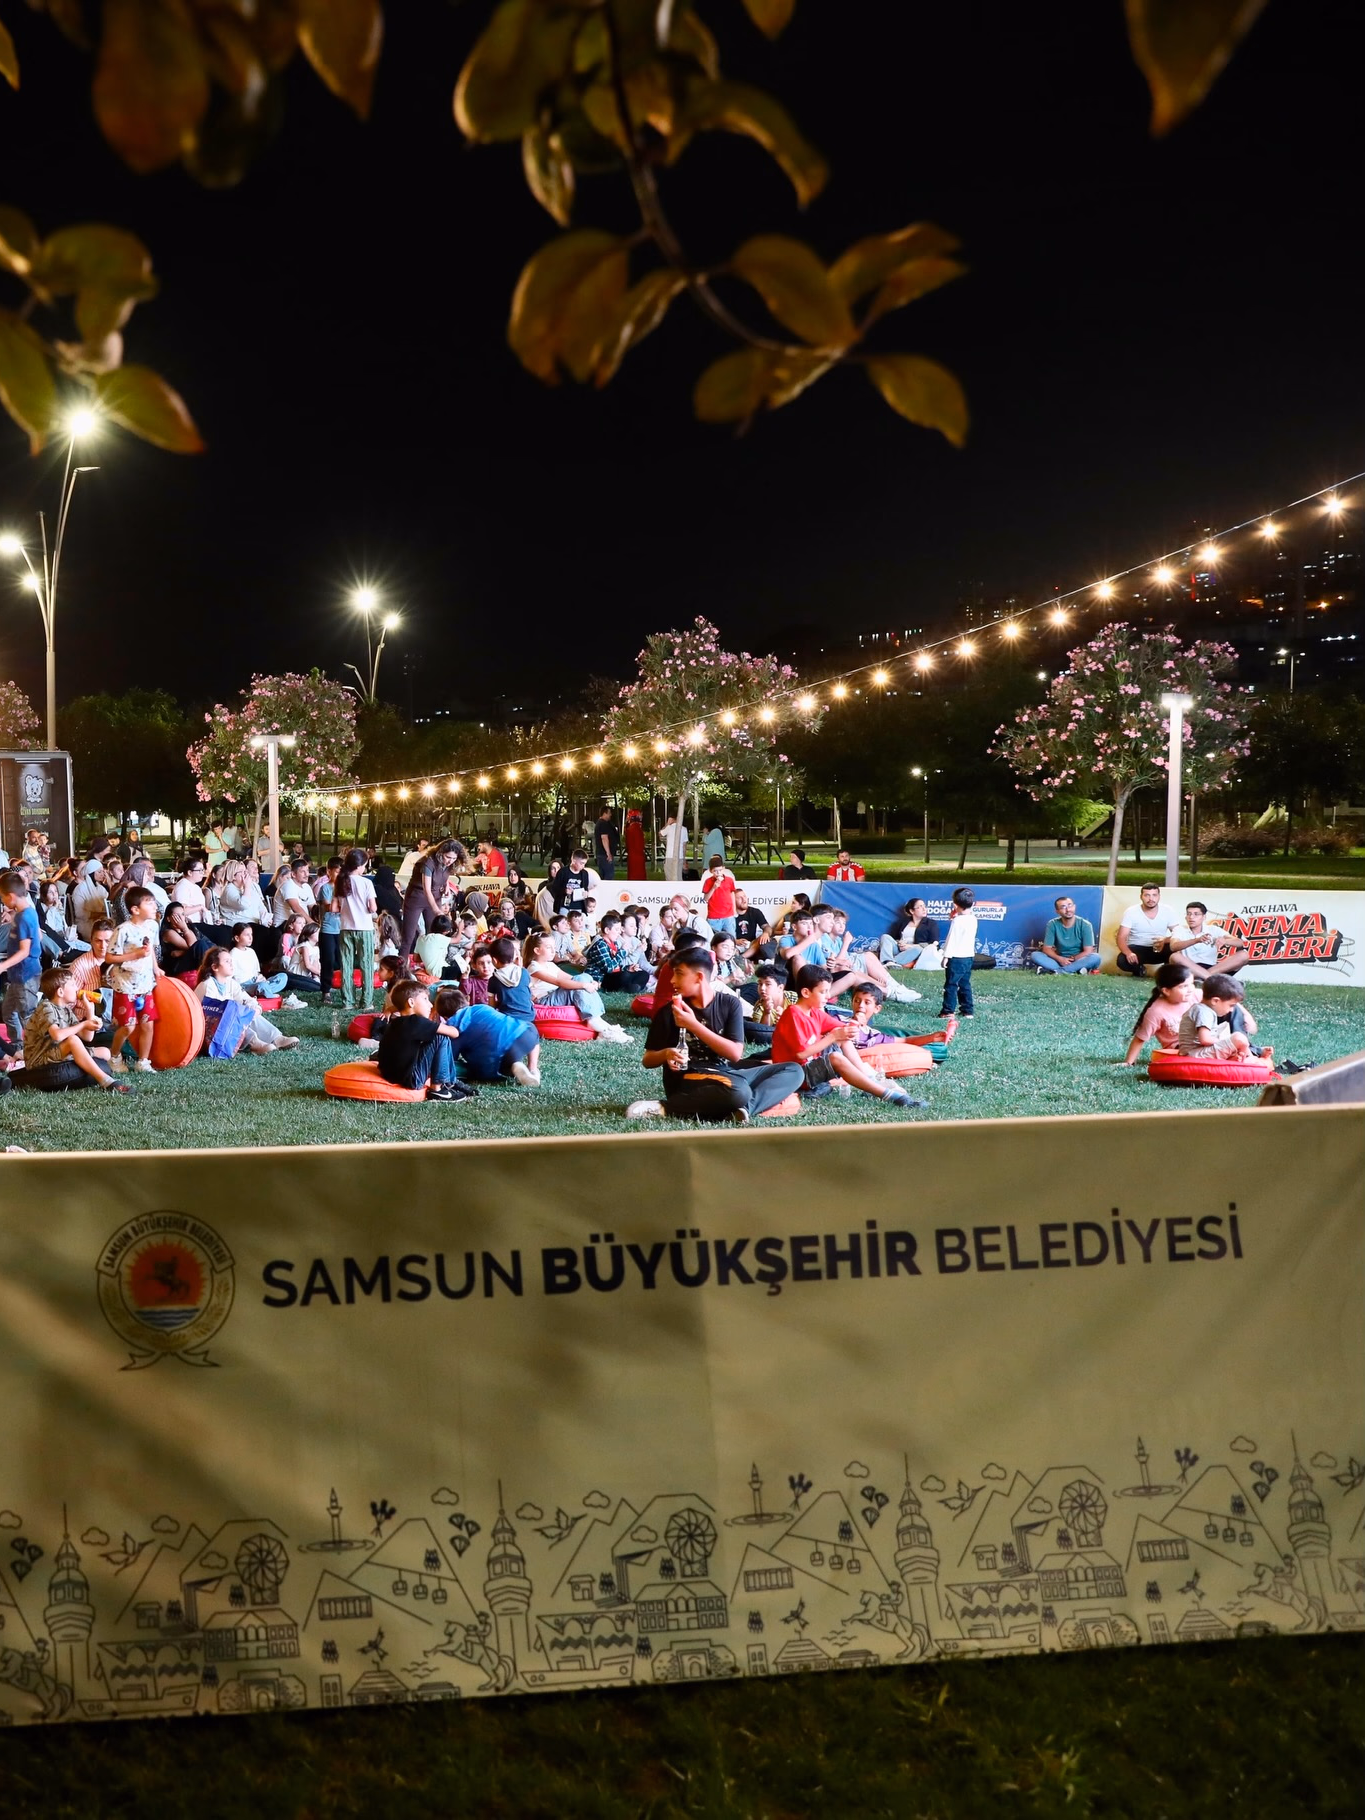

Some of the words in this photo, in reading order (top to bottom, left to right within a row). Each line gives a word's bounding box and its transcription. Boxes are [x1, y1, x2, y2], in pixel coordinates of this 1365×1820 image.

[747, 895, 787, 905] LEDİYESİ
[927, 906, 952, 914] DOĞA
[1240, 904, 1267, 916] AÇIK
[1268, 903, 1298, 913] HAVA
[103, 1231, 133, 1269] SAMSUN
[261, 1248, 525, 1309] SAMSUN
[541, 1219, 922, 1297] BÜYÜKŞEHİR
[934, 1201, 1244, 1274] BELEDİYESİ
